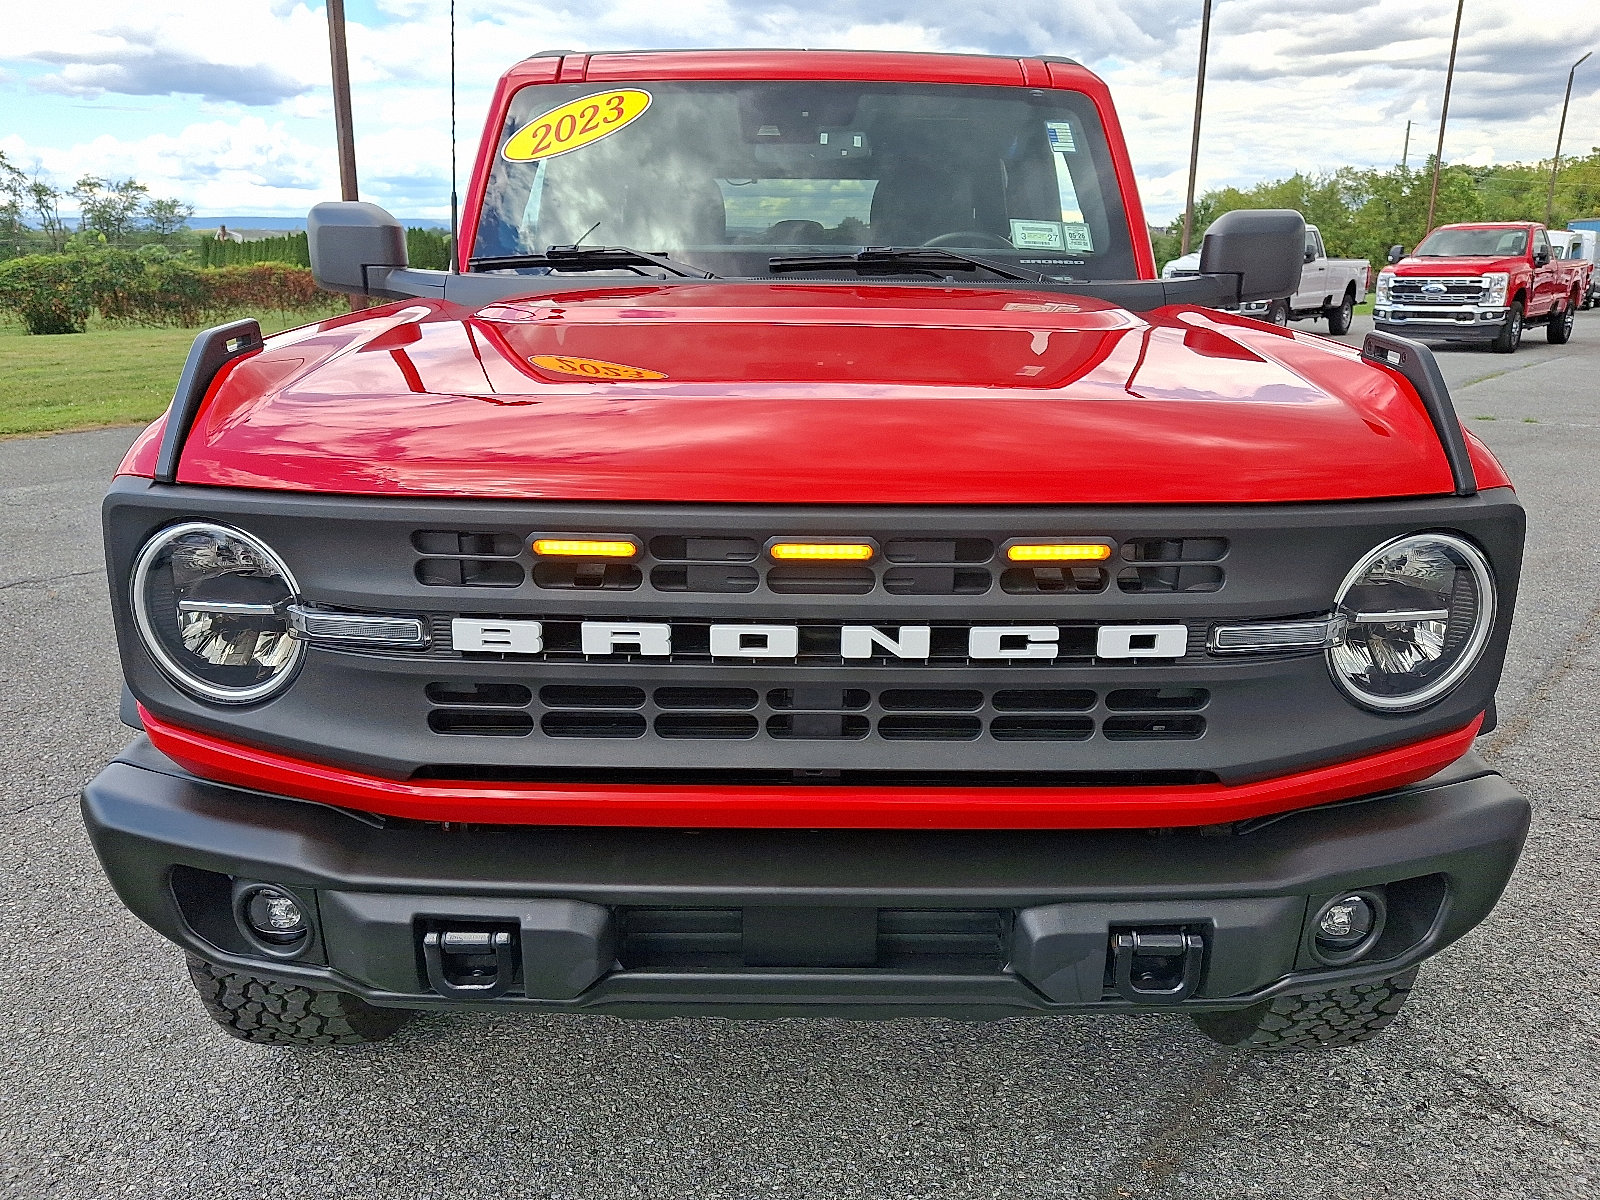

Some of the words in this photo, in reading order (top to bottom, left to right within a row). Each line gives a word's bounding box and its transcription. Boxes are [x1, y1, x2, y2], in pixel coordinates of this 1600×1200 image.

[531, 96, 625, 155] 2023
[1047, 234, 1058, 242] 27
[452, 618, 1188, 658] BRONCO
